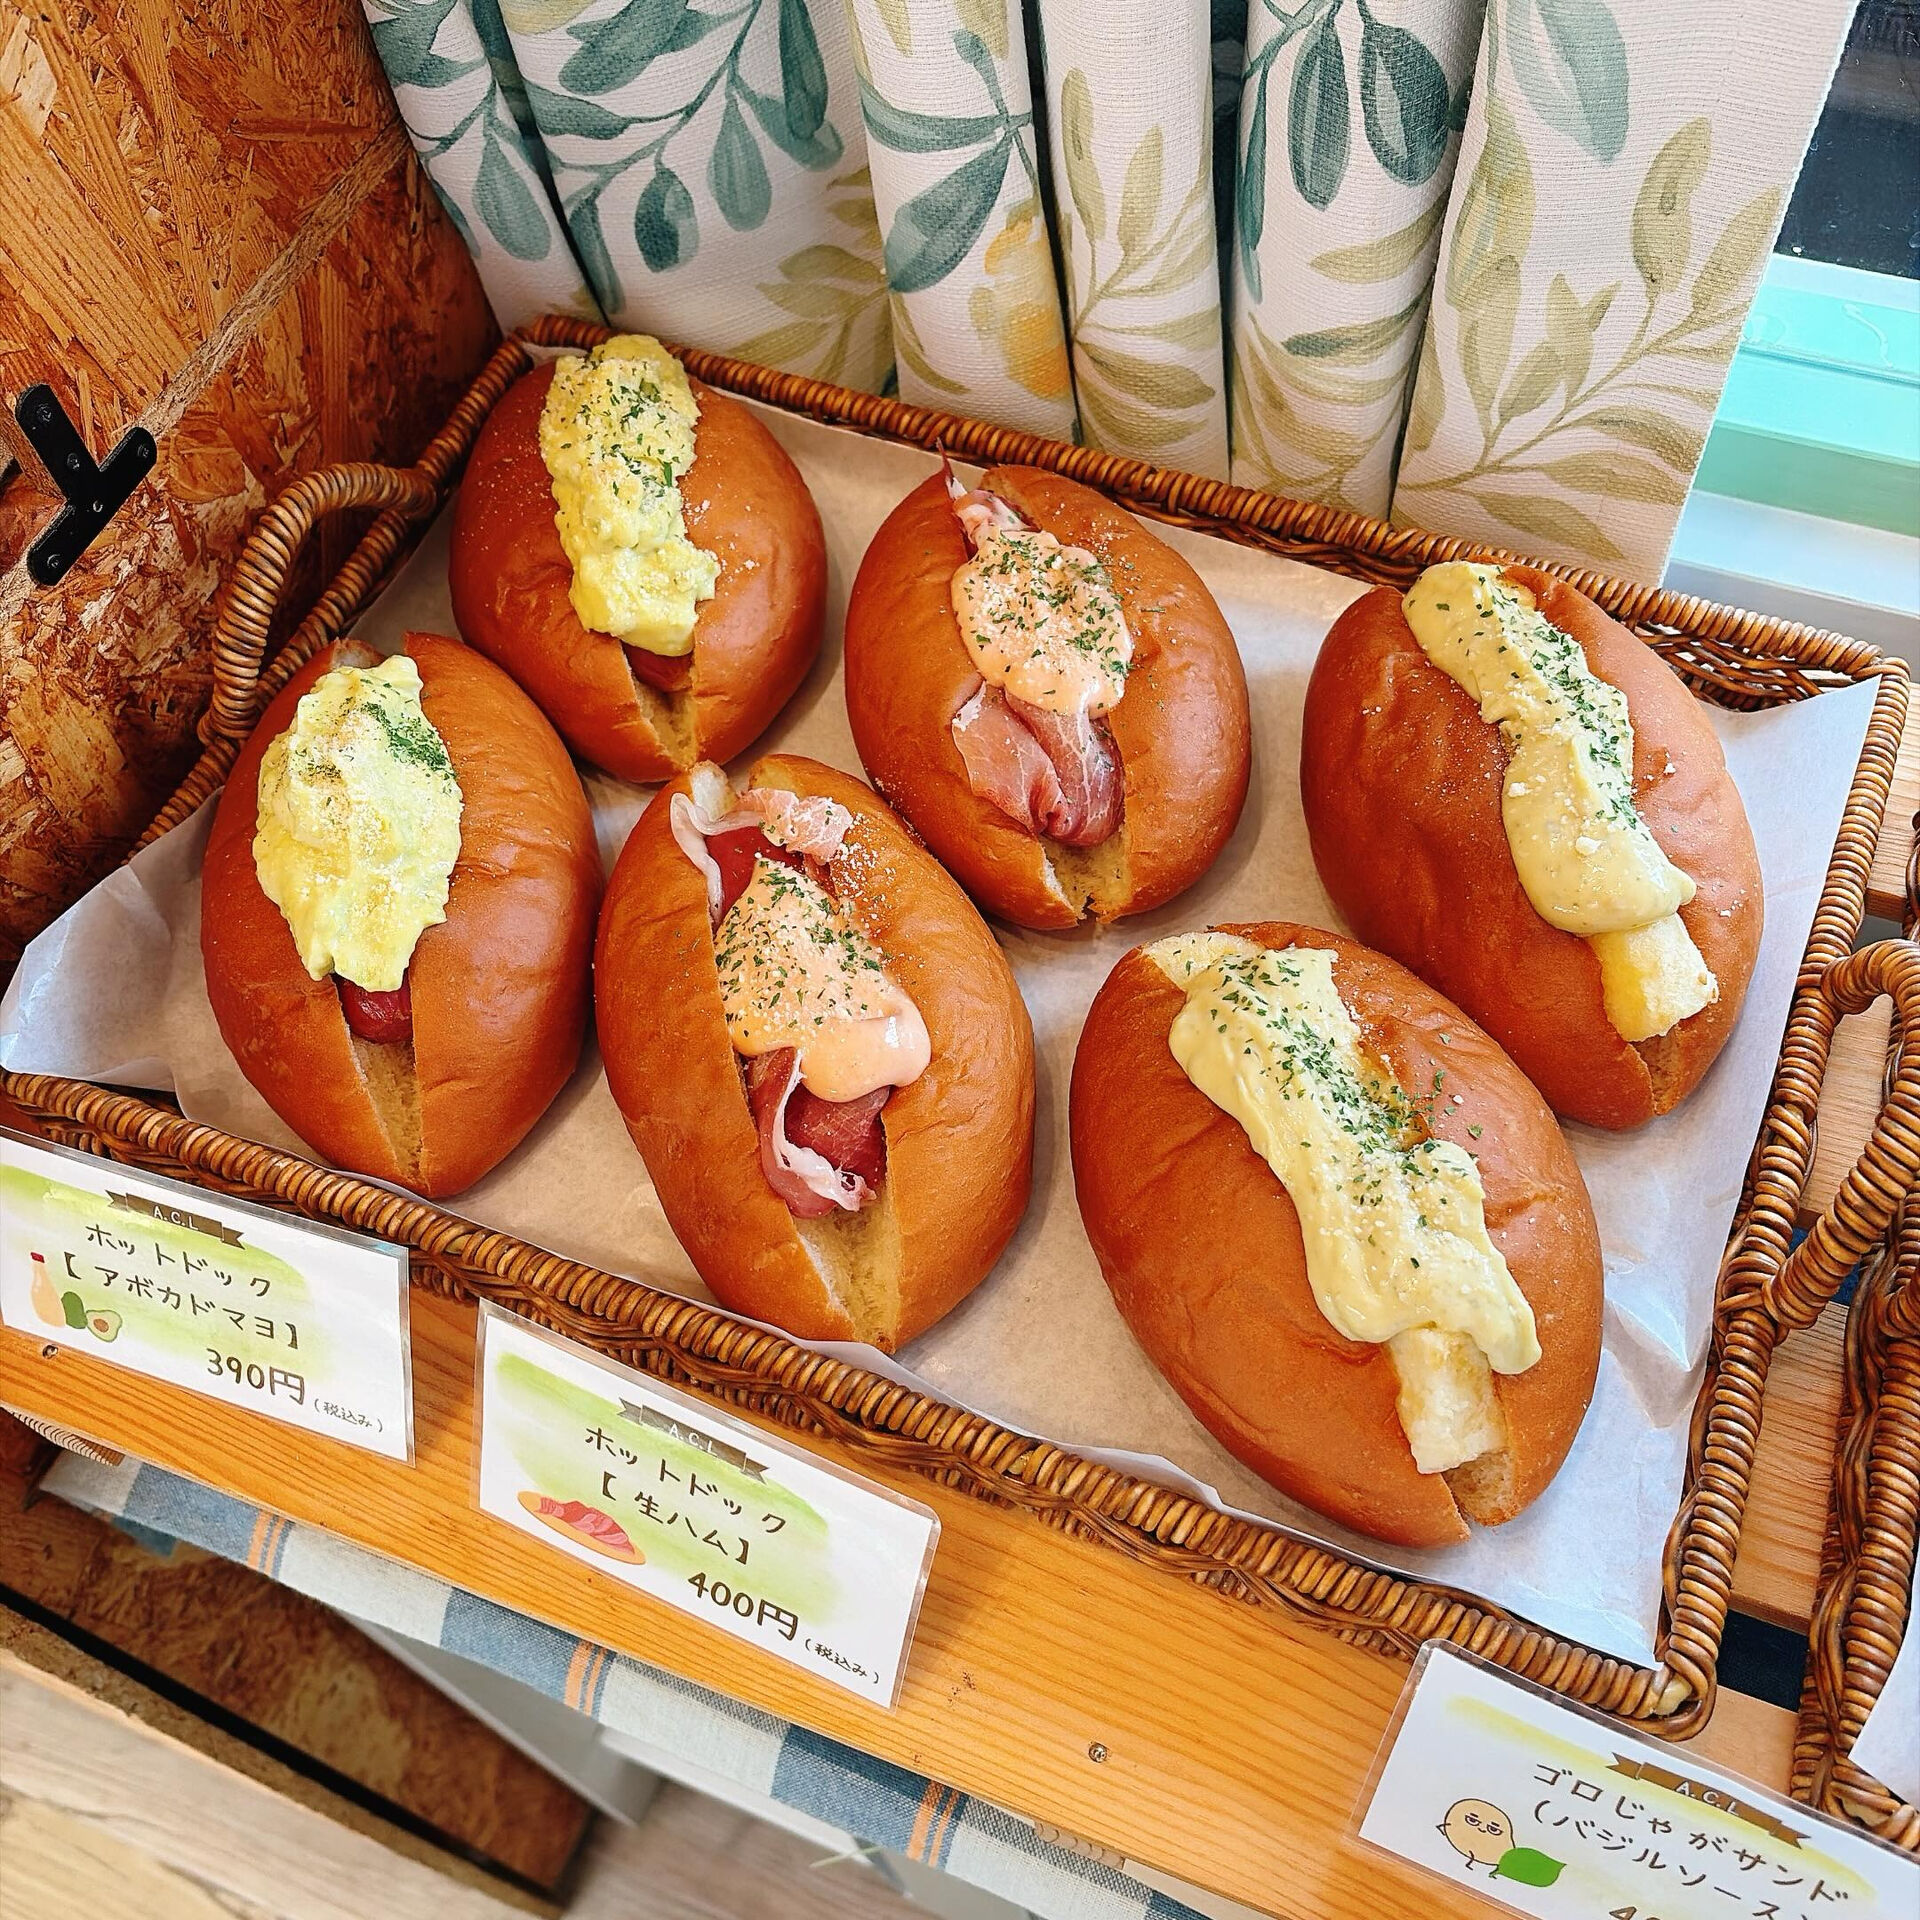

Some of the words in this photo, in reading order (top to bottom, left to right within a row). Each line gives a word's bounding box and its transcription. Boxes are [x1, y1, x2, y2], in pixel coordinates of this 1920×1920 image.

[153, 1204, 200, 1231] A.C.L
[85, 1224, 271, 1297] ホットドック
[63, 1251, 298, 1350] 【アボカドマヨ】
[206, 1348, 305, 1406] 390円
[669, 1421, 719, 1457] A.C.L
[585, 1427, 786, 1534] ホットドック
[602, 1471, 749, 1565] 【生ハム】
[687, 1572, 799, 1641] 400円
[1533, 1763, 1849, 1902] ゴロじゃがサンド
[1675, 1781, 1740, 1817] A.C.L
[1534, 1799, 1808, 1920] (バジルソース
